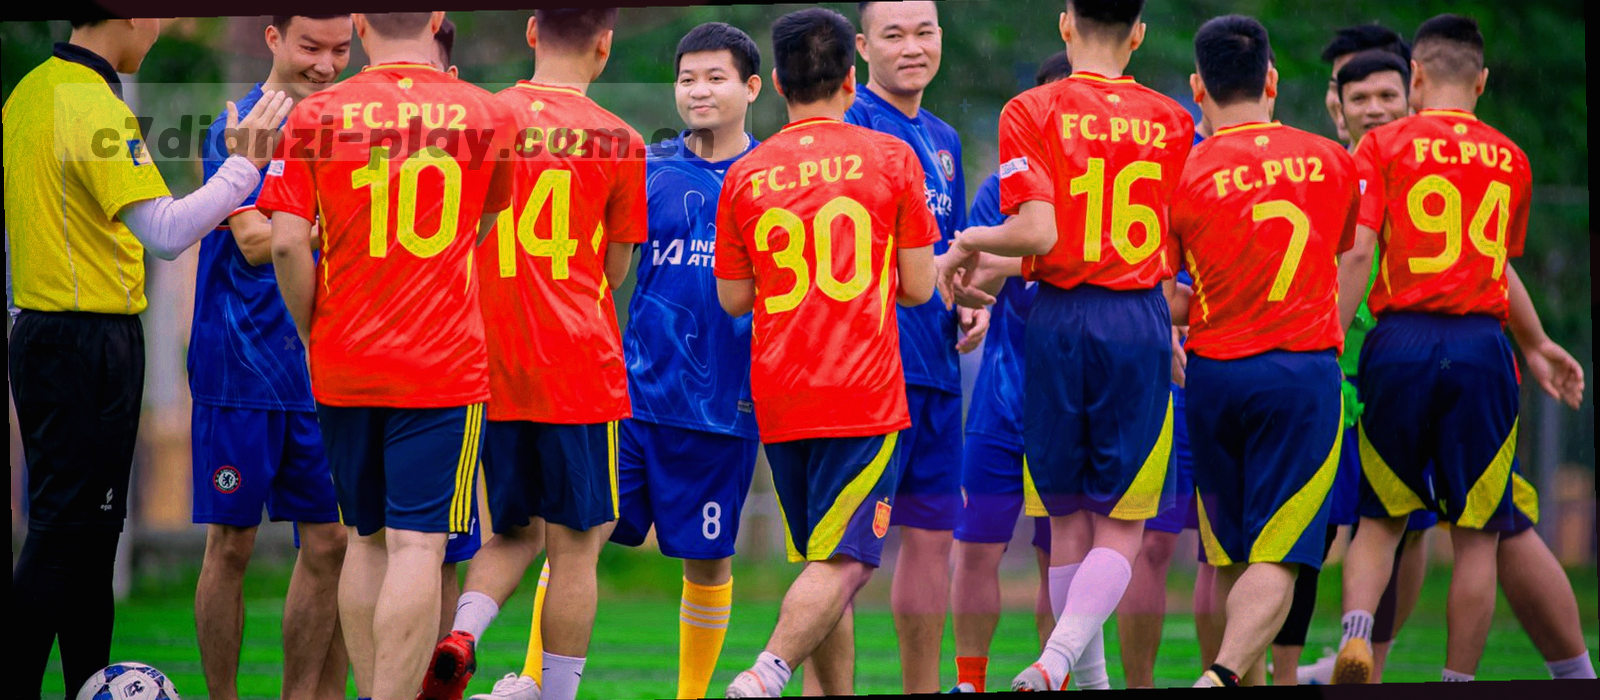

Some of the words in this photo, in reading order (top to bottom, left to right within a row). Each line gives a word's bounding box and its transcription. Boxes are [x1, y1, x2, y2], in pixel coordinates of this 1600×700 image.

[342, 102, 467, 130] FC.PU2
[1062, 113, 1167, 149] FC.PU2
[751, 155, 863, 197] FC.PU2
[1413, 138, 1513, 173] FC.PU2
[1213, 157, 1325, 197] FC.PU2
[351, 146, 462, 258] 10
[1070, 157, 1162, 265] 16
[1407, 174, 1511, 281] 94
[754, 196, 872, 315] 30
[1252, 199, 1310, 301] 7
[702, 501, 721, 540] 8
